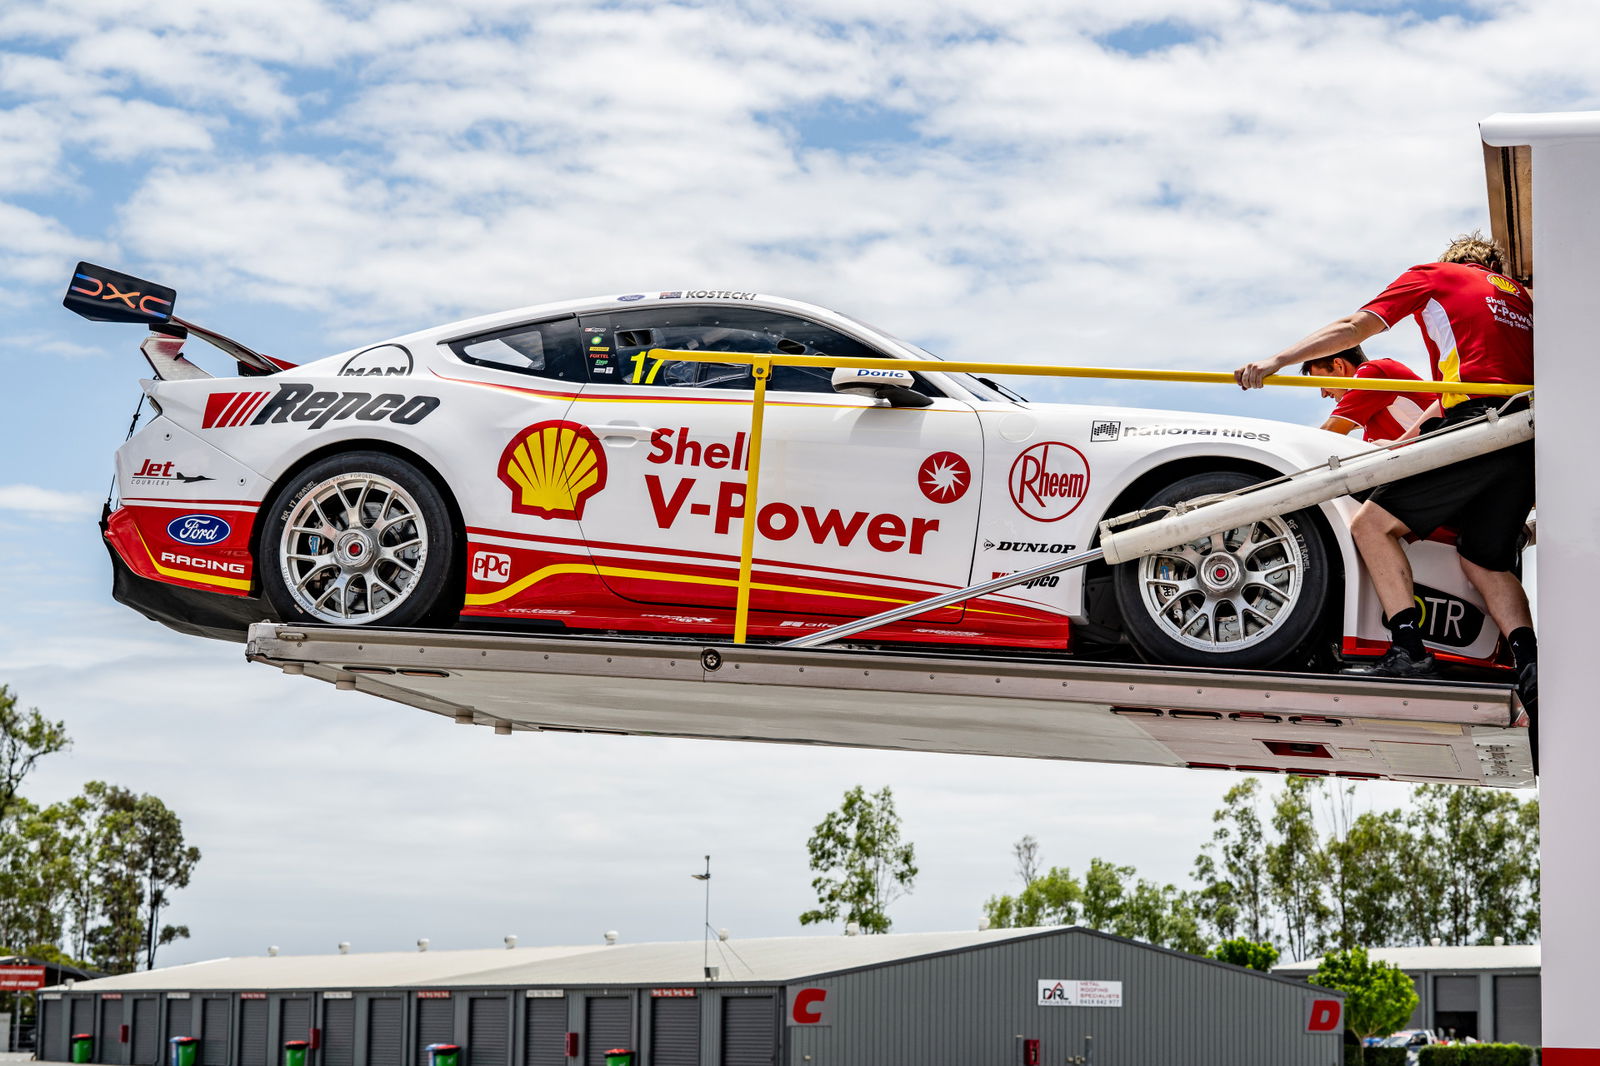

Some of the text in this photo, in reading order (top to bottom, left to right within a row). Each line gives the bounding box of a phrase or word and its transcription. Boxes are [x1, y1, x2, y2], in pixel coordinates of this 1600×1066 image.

[71, 273, 171, 318] DXC
[685, 290, 757, 300] KOSTECKI
[1485, 296, 1506, 306] Shell
[1494, 315, 1529, 331] Racing Team
[343, 366, 407, 377] MAN
[630, 351, 664, 384] 17
[857, 369, 904, 378] Doric
[250, 383, 440, 430] Repco
[1123, 425, 1271, 442] national tiles
[133, 458, 175, 477] Jet
[1018, 445, 1084, 508] Rheem
[295, 480, 318, 500] TRAVEL
[644, 474, 940, 555] V-Power
[179, 518, 220, 540] Ford
[996, 541, 1076, 554] DUNLOP
[1299, 543, 1311, 572] TRAVEL
[161, 552, 245, 574] RACING
[474, 554, 509, 579] PPG
[1043, 987, 1069, 1000] DRL
[793, 988, 827, 1024] C
[1308, 1000, 1340, 1031] D
